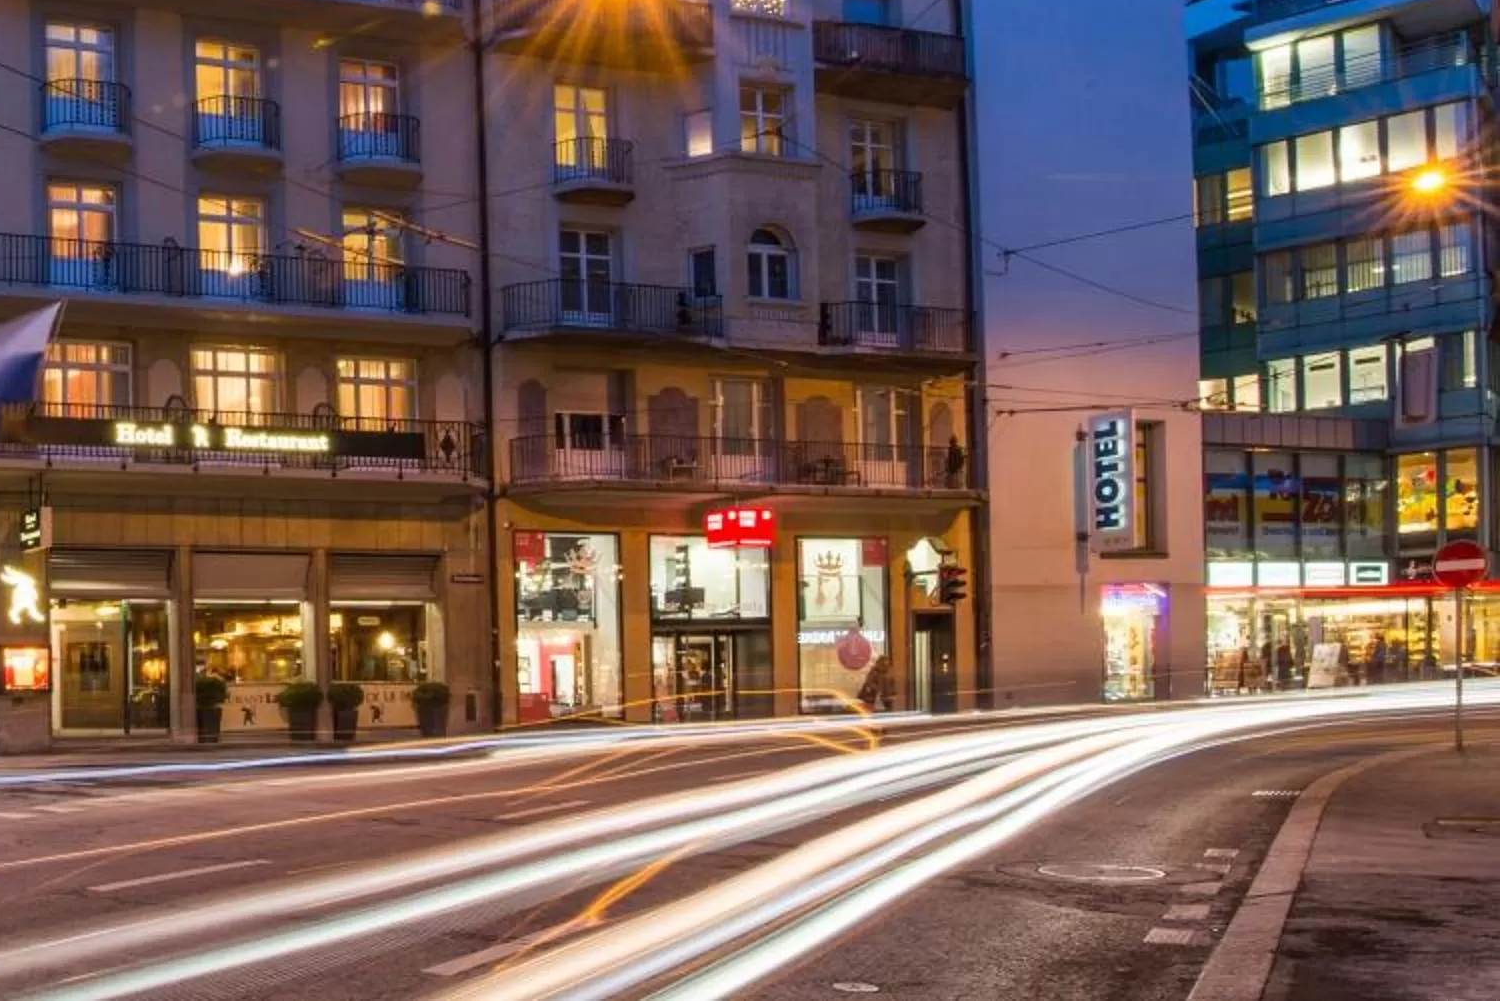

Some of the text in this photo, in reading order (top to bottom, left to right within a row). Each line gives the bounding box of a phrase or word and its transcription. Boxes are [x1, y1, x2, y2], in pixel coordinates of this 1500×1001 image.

[115, 422, 329, 451] Hotel Restaurant
[1094, 420, 1122, 530] HOTEL
